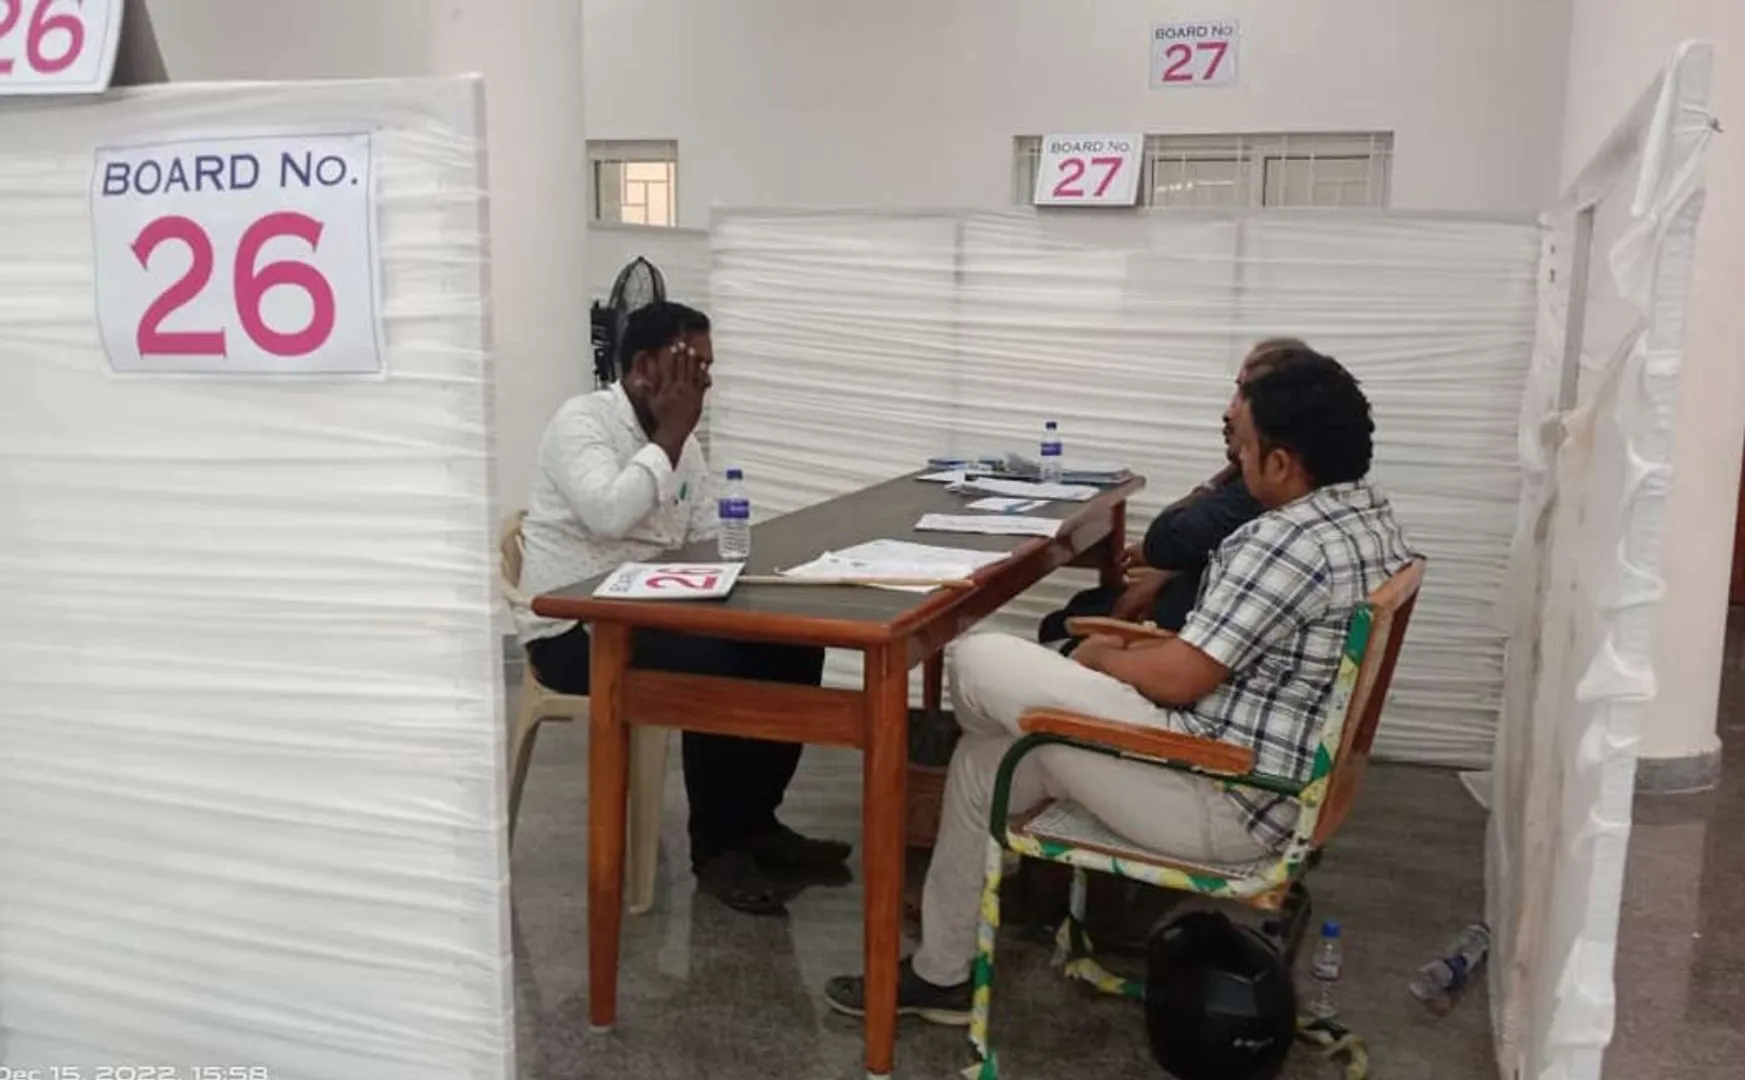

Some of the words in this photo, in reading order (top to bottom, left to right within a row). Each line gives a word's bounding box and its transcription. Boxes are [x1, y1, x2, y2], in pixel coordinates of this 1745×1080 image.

[1154, 26, 1208, 40] BOARD
[1162, 41, 1229, 82] 27
[1050, 141, 1104, 154] BOARD
[102, 153, 260, 197] BOARD
[1052, 157, 1124, 197] 27
[129, 210, 336, 361] 26
